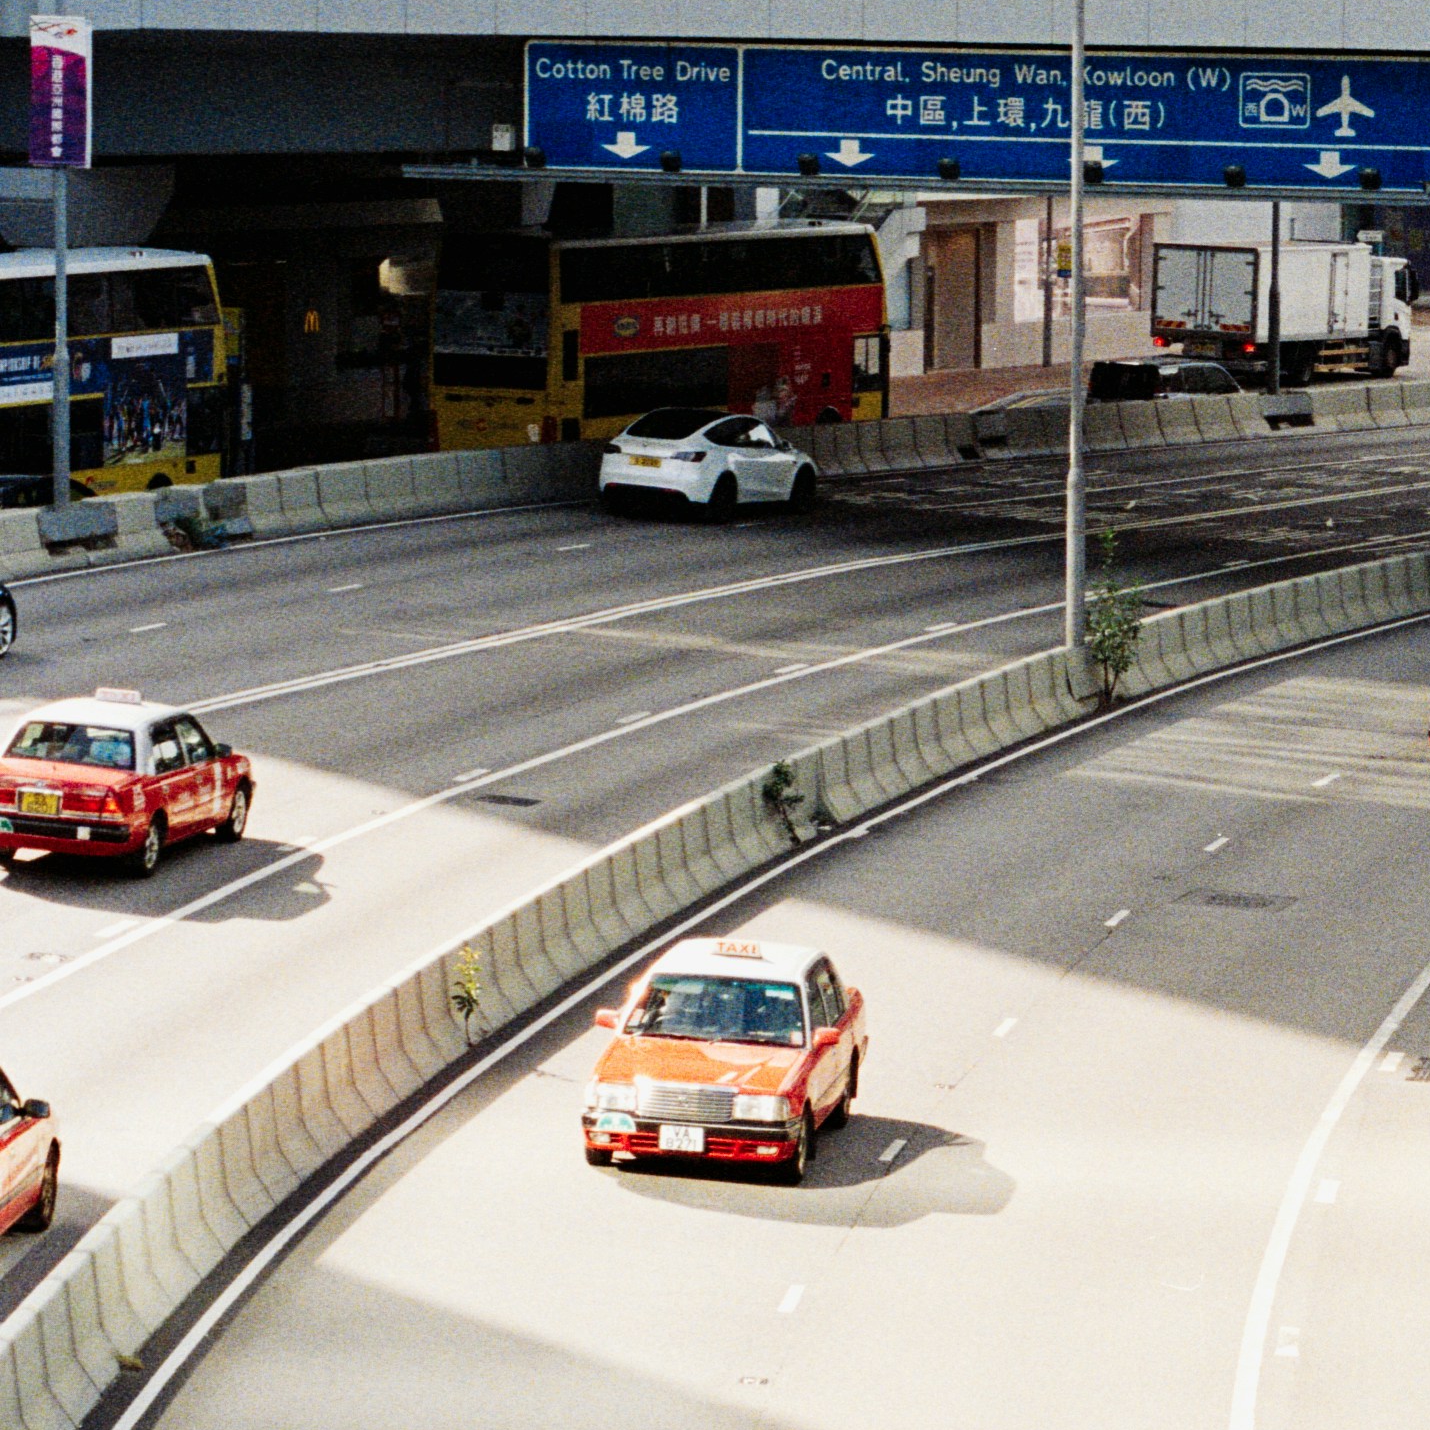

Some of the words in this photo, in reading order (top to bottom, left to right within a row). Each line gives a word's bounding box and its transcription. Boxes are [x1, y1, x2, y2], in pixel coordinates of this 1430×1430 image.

[535, 57, 611, 79] Cotton
[619, 59, 664, 80] Tree
[675, 60, 731, 82] Drive
[921, 61, 1001, 88] Sheung
[1014, 63, 1067, 87] Wan,
[1082, 65, 1175, 87] Kowloon
[1187, 66, 1231, 92] (W)
[586, 92, 679, 124] 紅棉路
[1290, 103, 1307, 116] W
[716, 941, 758, 954] TAXI
[673, 1125, 691, 1139] VA
